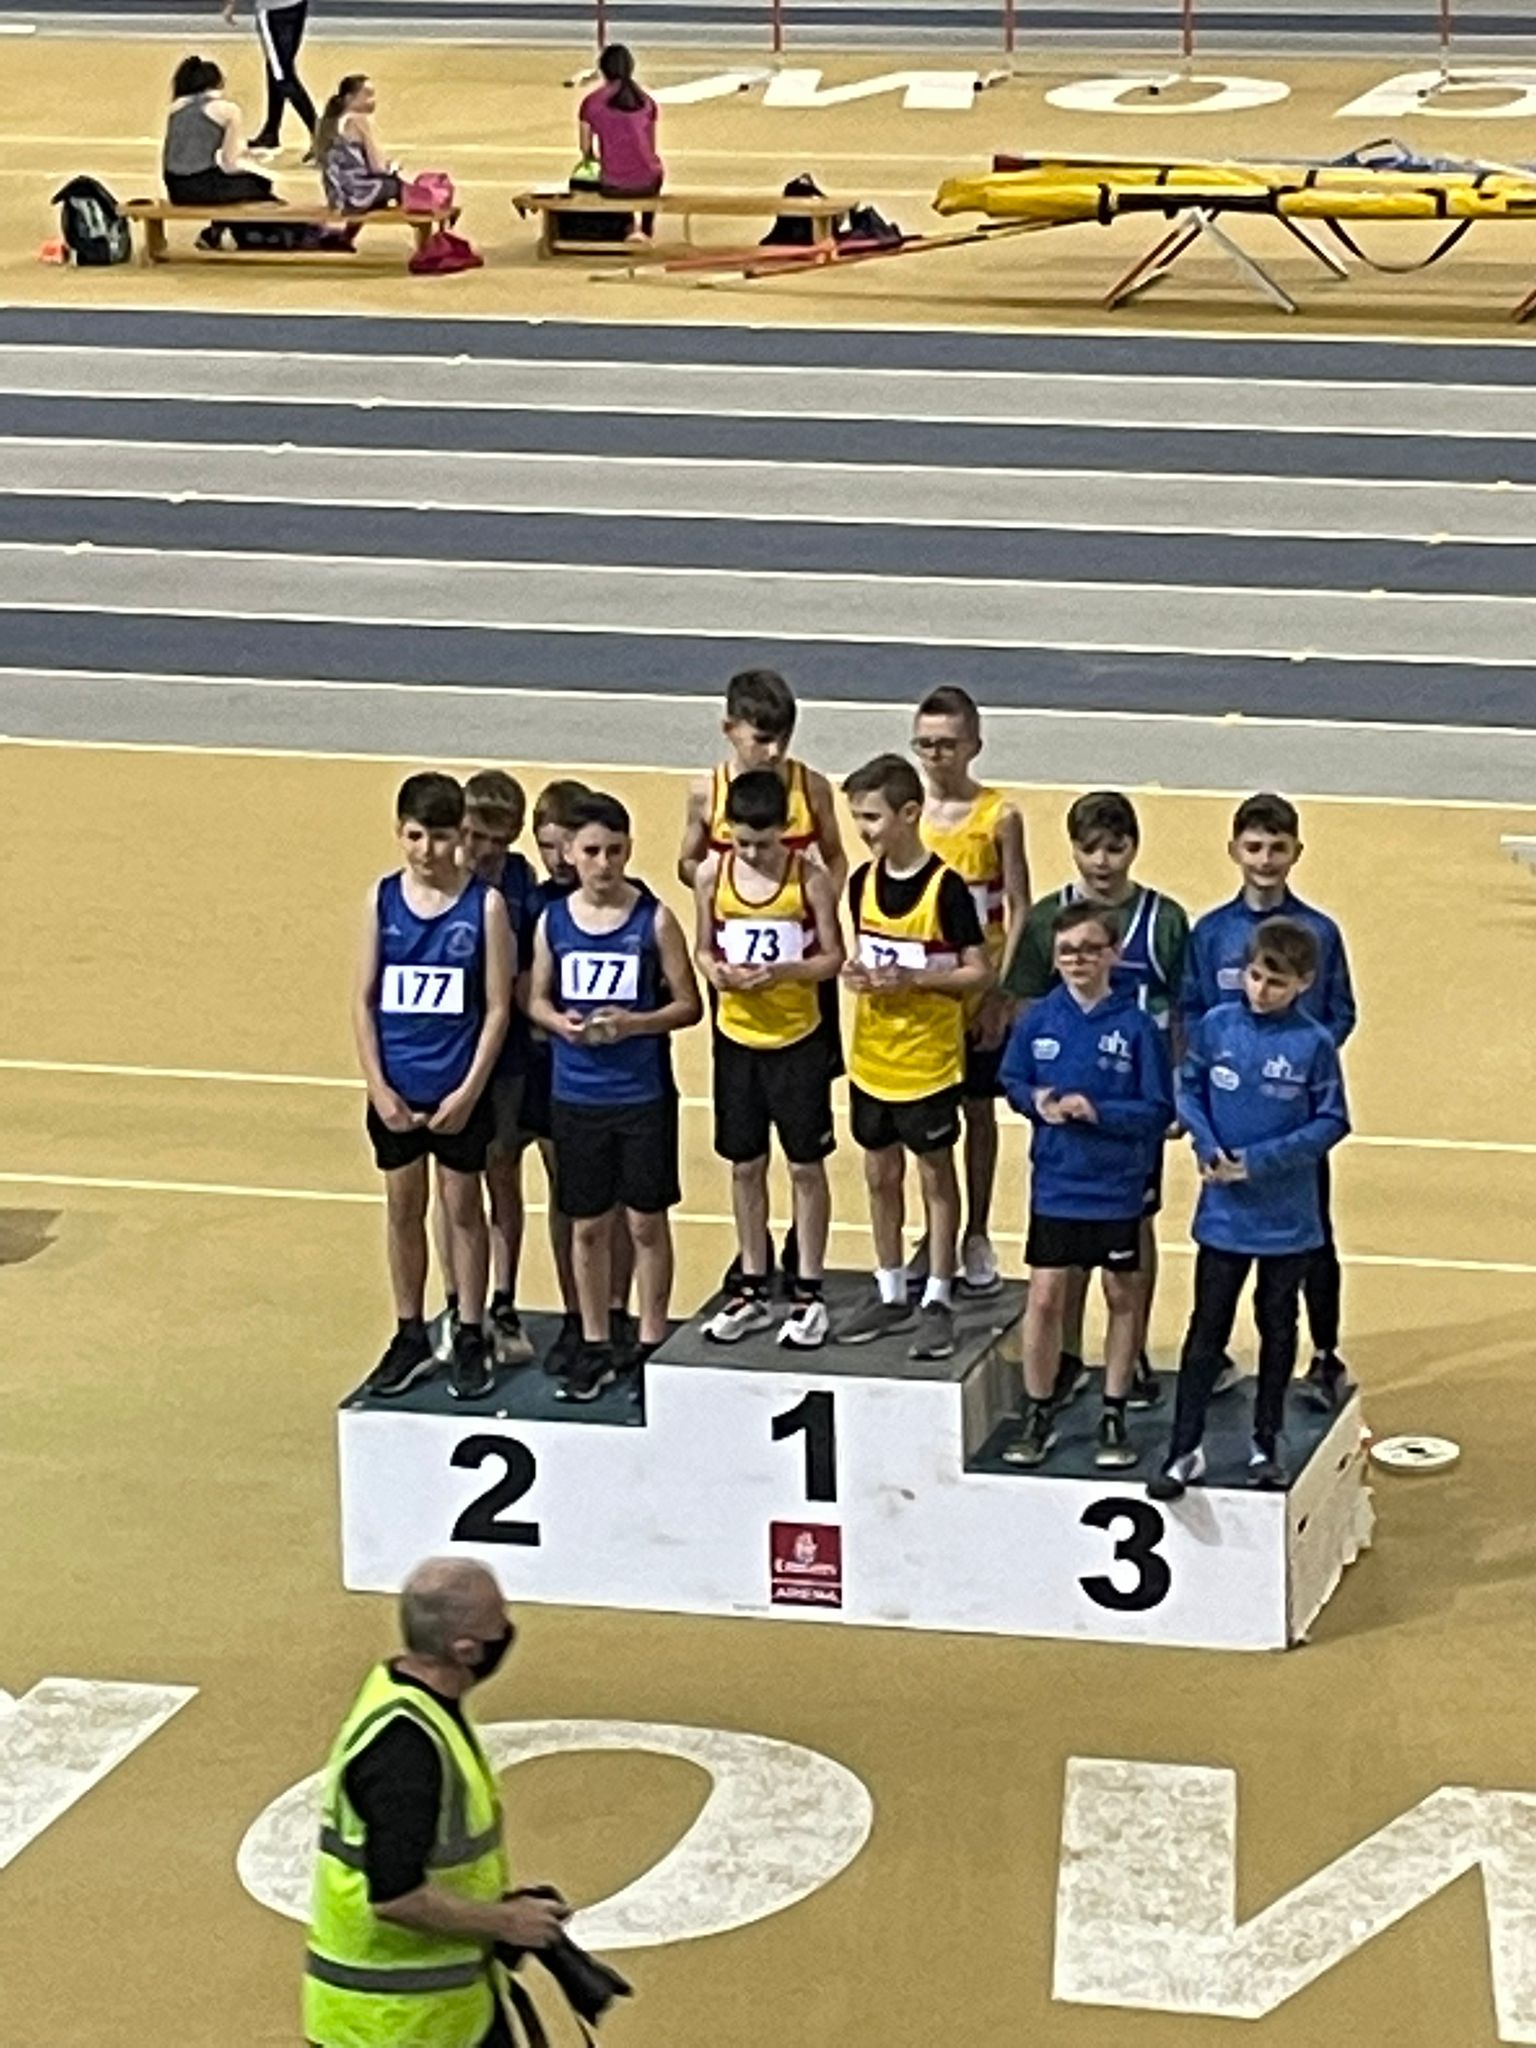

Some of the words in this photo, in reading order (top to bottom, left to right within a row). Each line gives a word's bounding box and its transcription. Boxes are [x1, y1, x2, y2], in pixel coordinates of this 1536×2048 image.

[571, 957, 627, 996] 177
[745, 928, 781, 962] 73
[397, 970, 453, 1008] 177
[771, 1390, 837, 1502] 1
[450, 1434, 541, 1547] 2
[1079, 1497, 1171, 1611] 3
